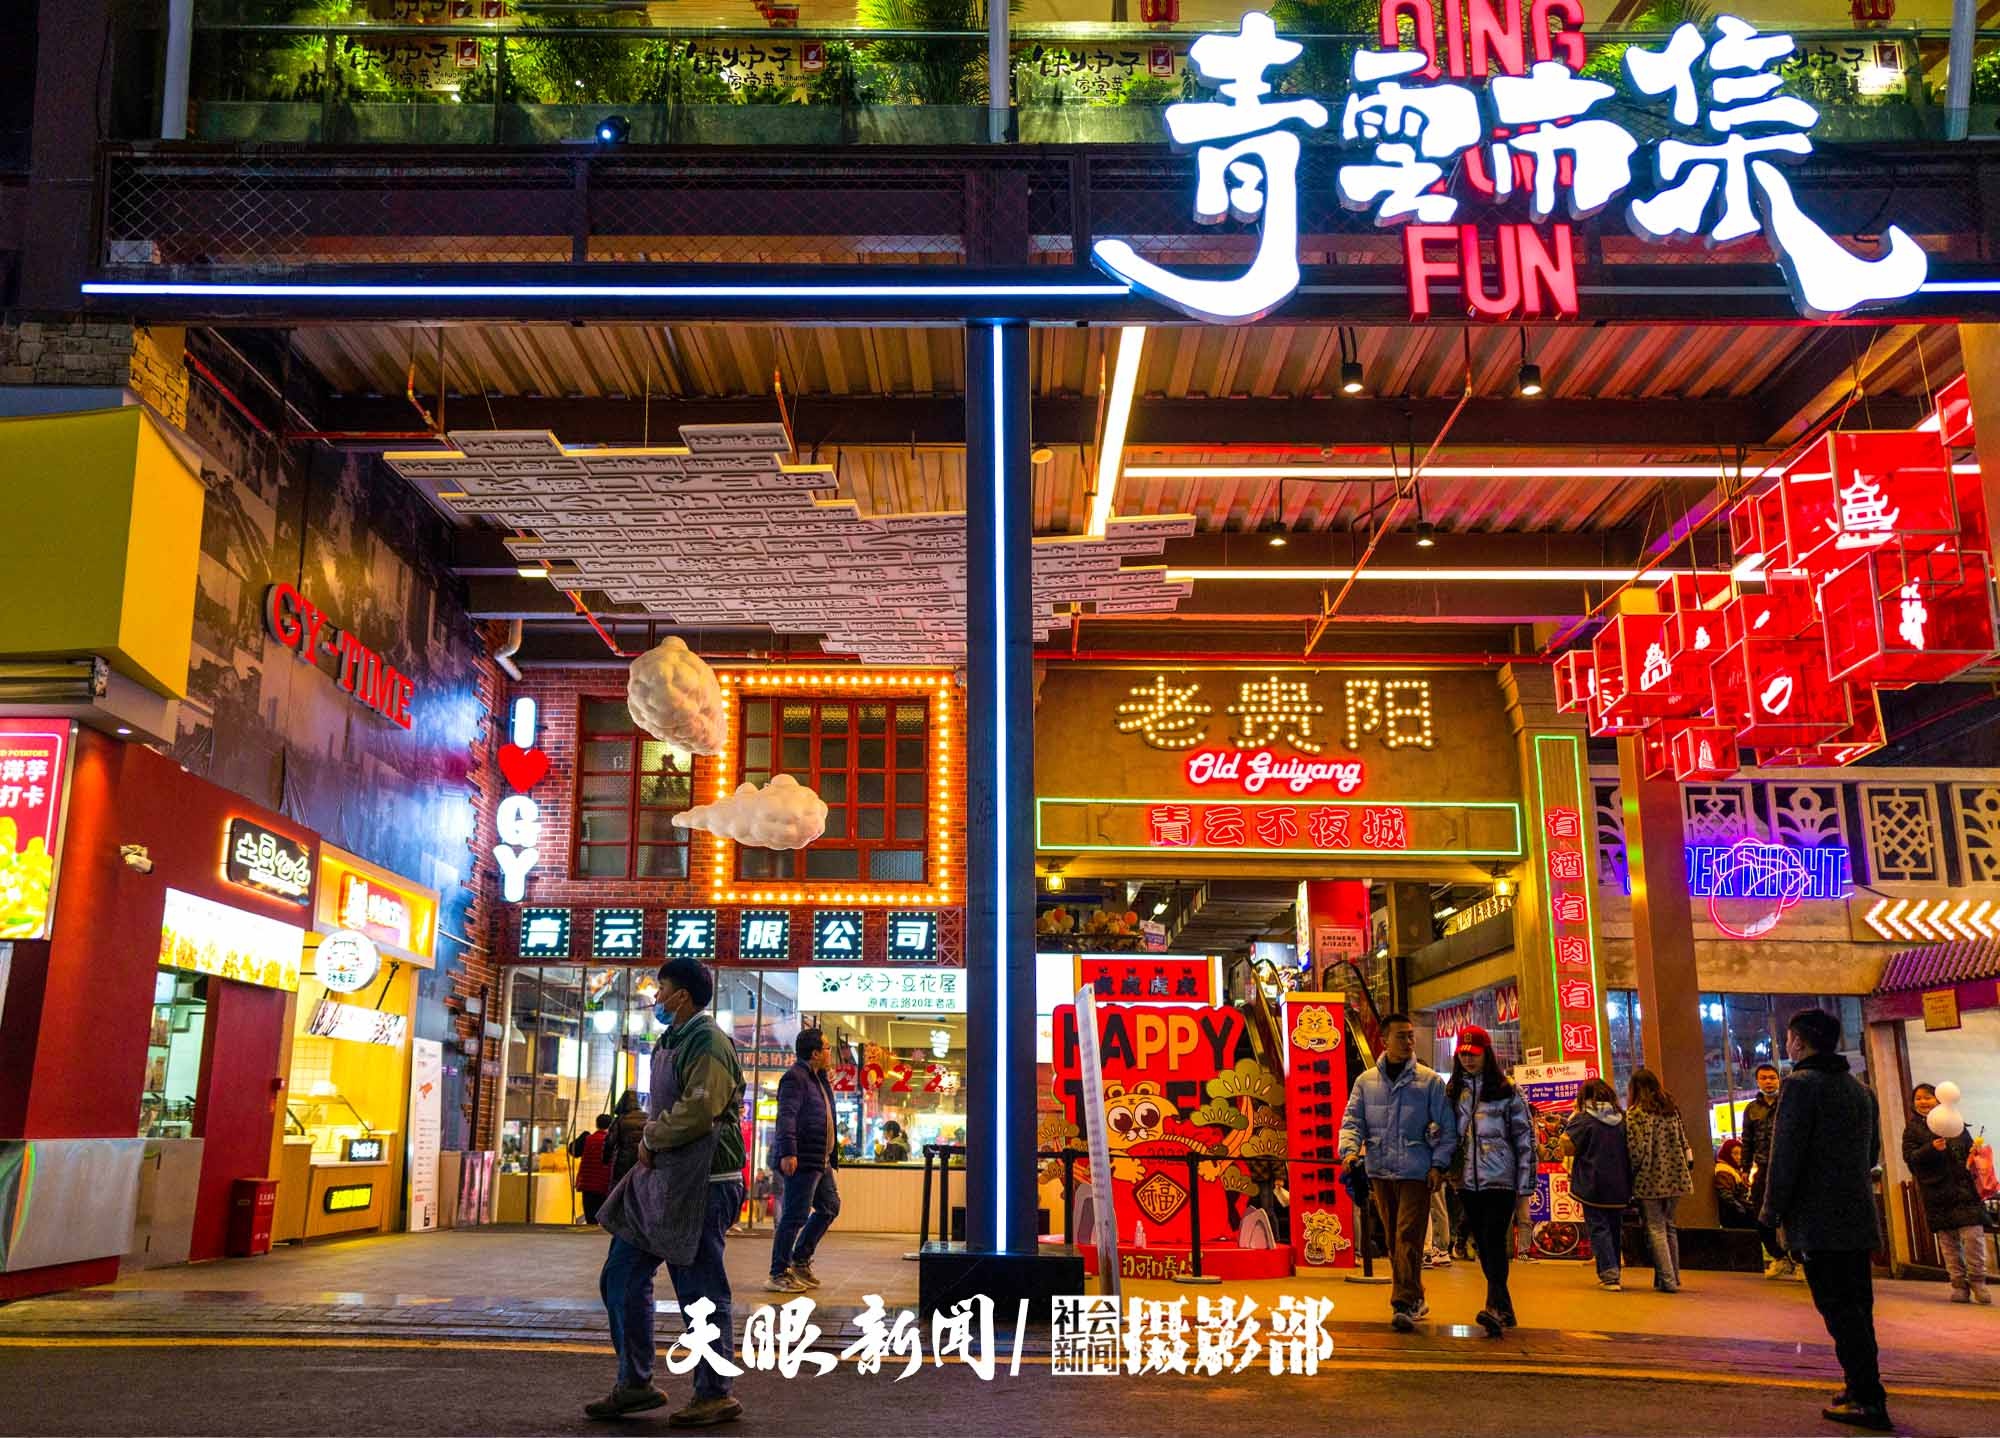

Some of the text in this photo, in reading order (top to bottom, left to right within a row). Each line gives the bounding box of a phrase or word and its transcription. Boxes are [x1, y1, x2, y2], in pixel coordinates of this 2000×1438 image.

[1379, 0, 1587, 78] QING
[1075, 76, 1127, 96] 家常菜
[1403, 223, 1580, 322] FUN
[263, 582, 415, 732] GY-TIME
[1116, 674, 1433, 753] 老贵阳
[0, 759, 48, 783] 洋芋
[1189, 752, 1361, 793] Old Guiyang
[1150, 806, 1406, 848] 青云不夜城
[1742, 846, 1848, 898] NIGHT
[527, 918, 930, 951] 青云无限公司
